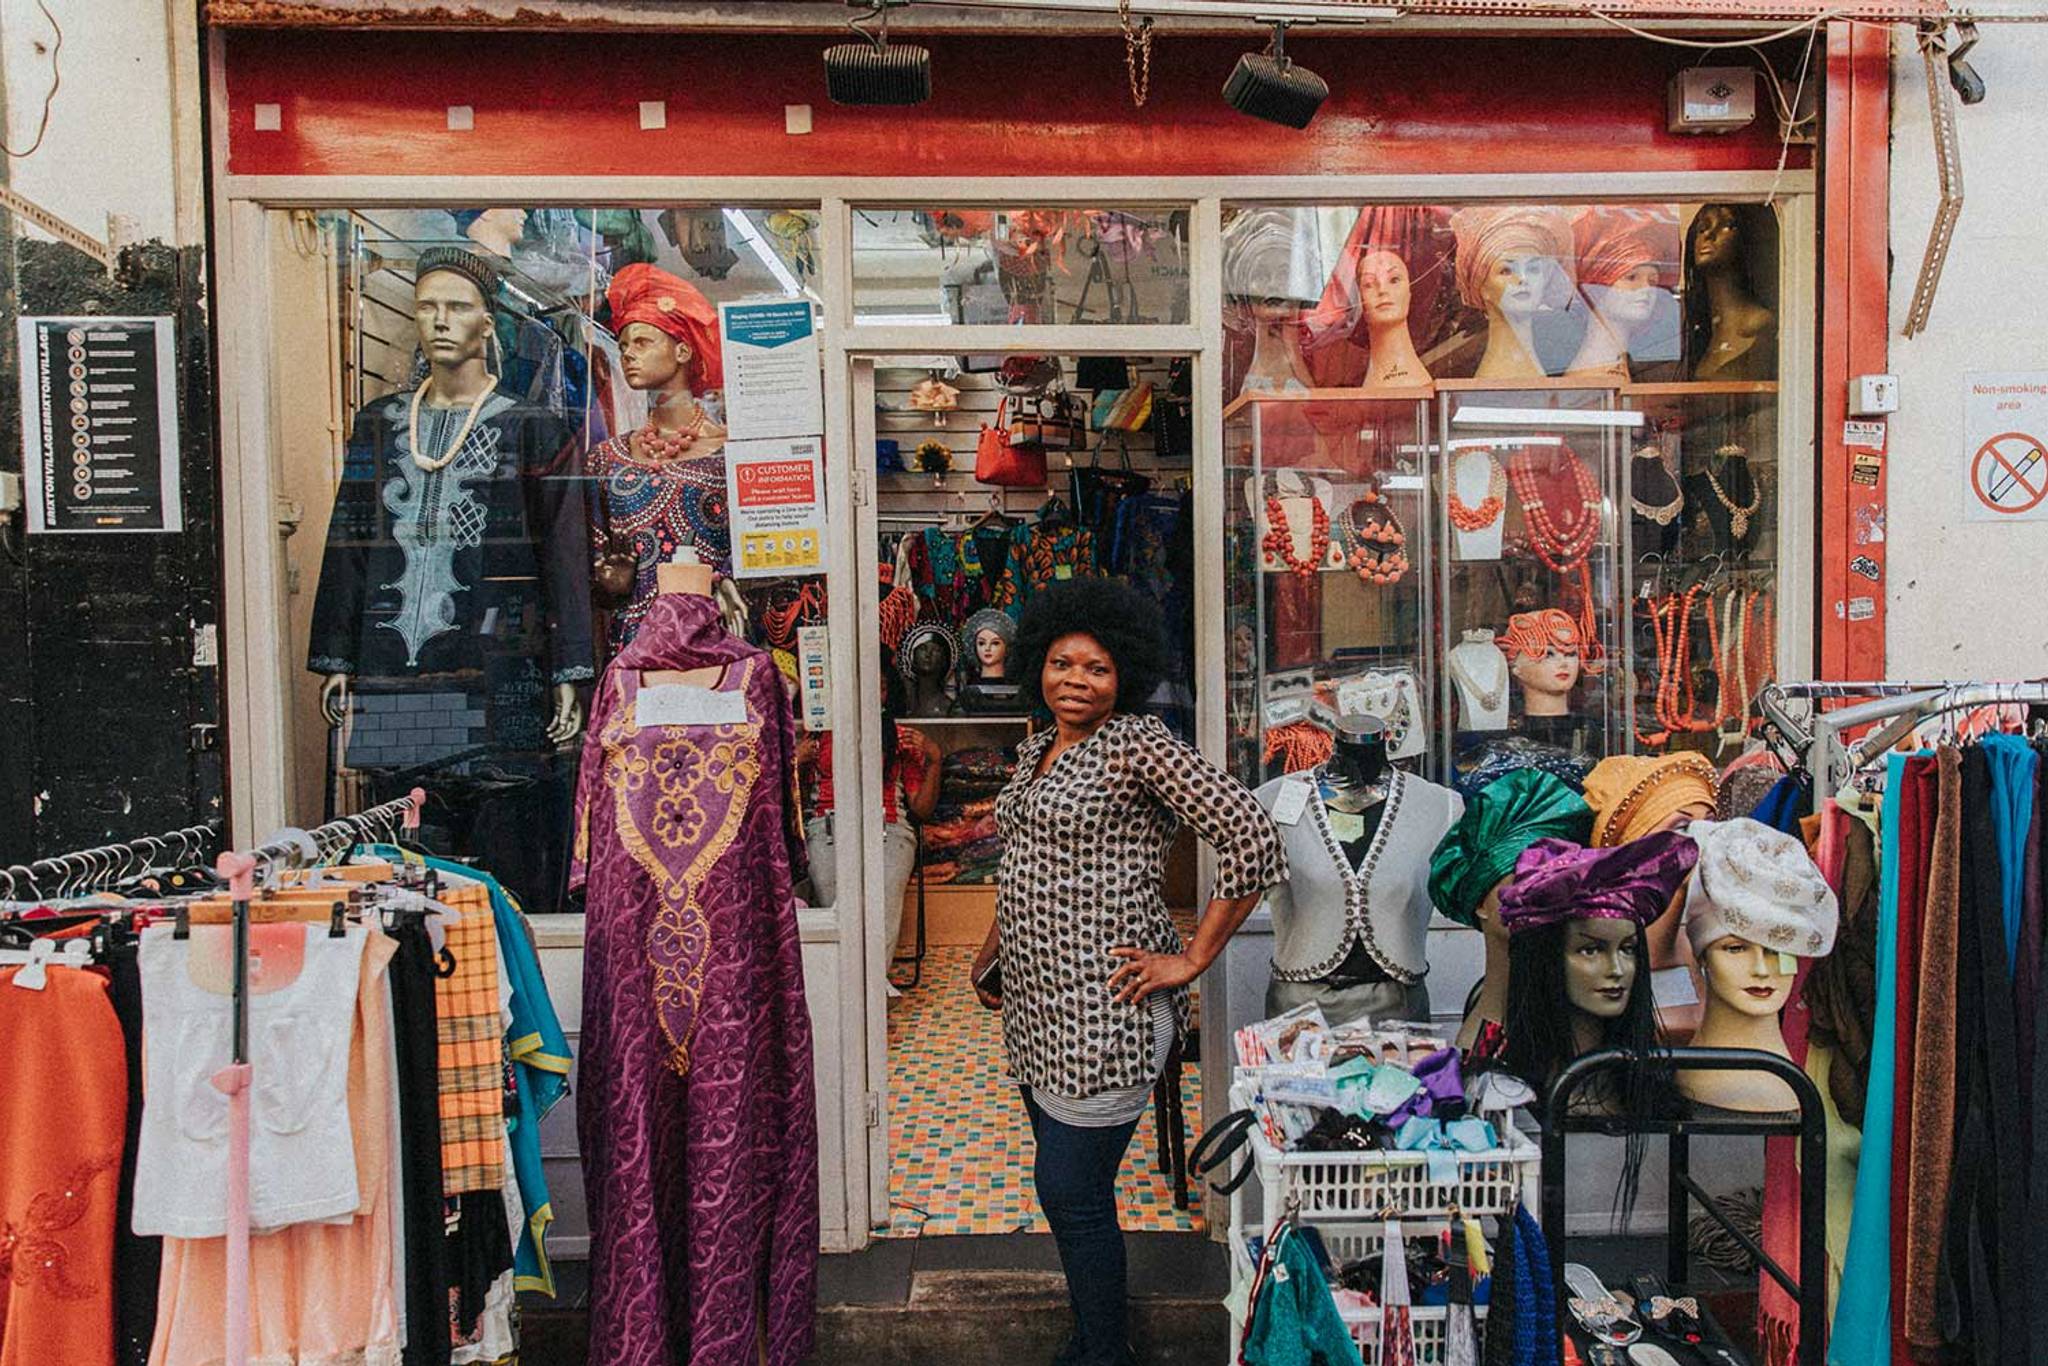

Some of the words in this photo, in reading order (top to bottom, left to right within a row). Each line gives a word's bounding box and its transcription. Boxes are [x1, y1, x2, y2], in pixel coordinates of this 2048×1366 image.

[1972, 382, 2048, 398] Non-smoking
[1996, 401, 2022, 410] area
[757, 464, 811, 475] CUSTOMER
[758, 474, 811, 483] INFORMATION
[762, 494, 791, 502] customer
